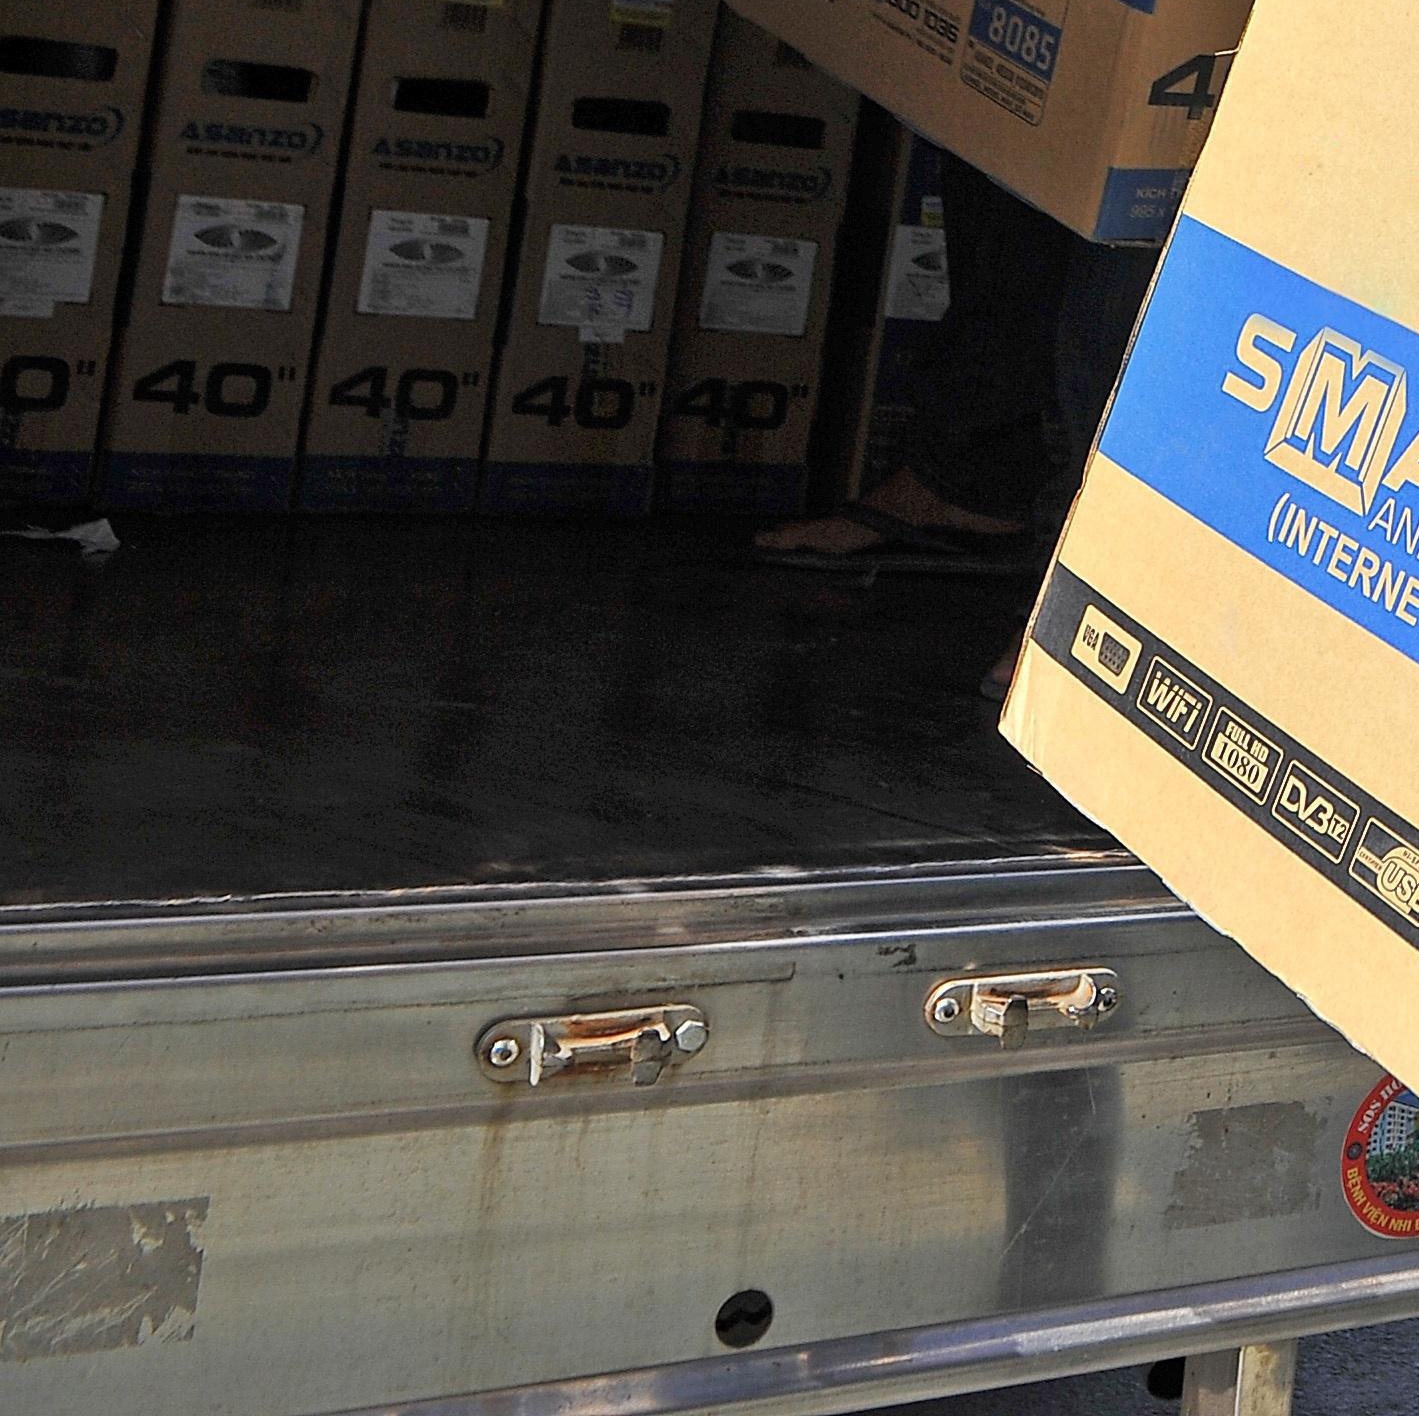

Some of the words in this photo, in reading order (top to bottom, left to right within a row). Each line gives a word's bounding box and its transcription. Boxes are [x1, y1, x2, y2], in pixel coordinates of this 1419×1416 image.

[988, 5, 1055, 71] 8085
[1148, 53, 1217, 119] 4
[1, 355, 97, 411] 0"
[133, 359, 296, 418] 40"
[328, 365, 479, 421] 40"
[511, 374, 656, 430] 40"
[1082, 624, 1100, 651] VGA
[1218, 741, 1260, 785] 1080
[1225, 720, 1251, 751] FULL
[1250, 739, 1270, 763] HD
[1389, 1217, 1412, 1233] NHI
